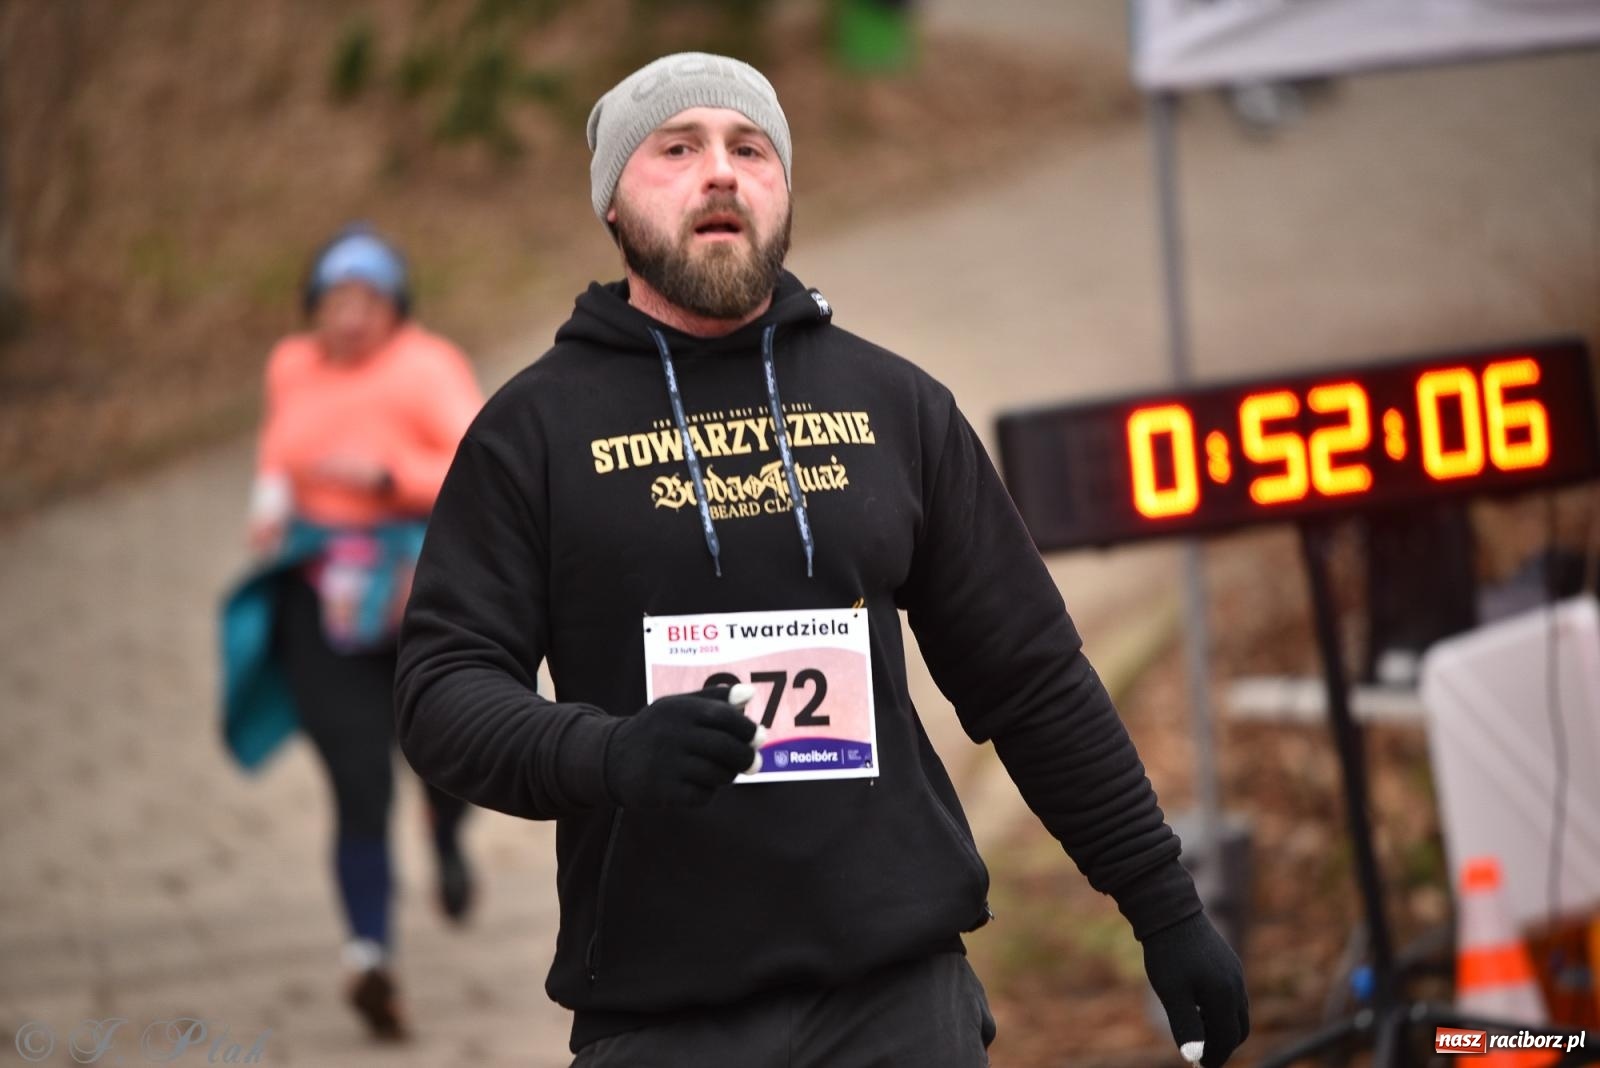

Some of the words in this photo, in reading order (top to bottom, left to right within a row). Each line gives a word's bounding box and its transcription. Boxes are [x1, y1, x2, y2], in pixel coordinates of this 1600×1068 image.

[709, 501, 761, 520] BEARD
[667, 624, 720, 642] BIEG
[726, 619, 850, 639] Twardziela
[702, 668, 831, 729] 72
[789, 749, 839, 764] Racibórz
